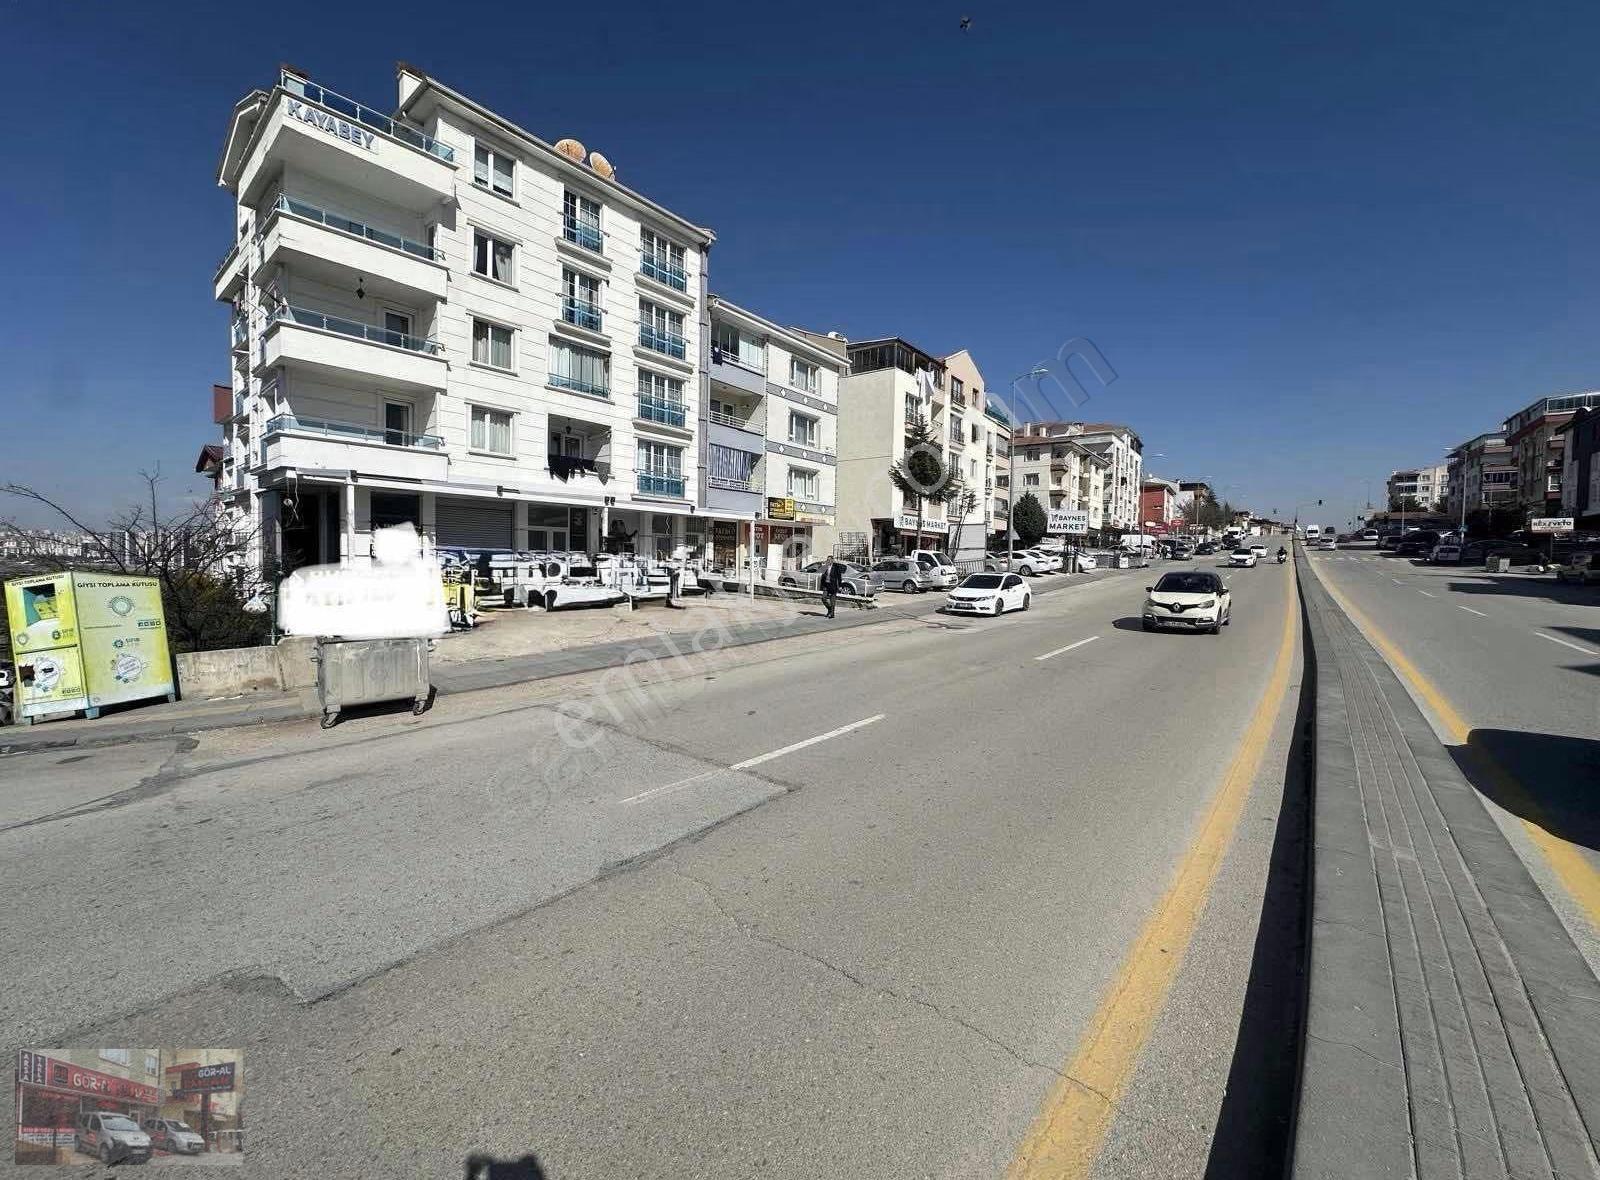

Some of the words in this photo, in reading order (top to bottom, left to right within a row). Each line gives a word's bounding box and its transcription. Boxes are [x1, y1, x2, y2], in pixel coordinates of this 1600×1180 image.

[287, 98, 375, 150] KAYABEY
[904, 517, 926, 527] BAYS
[926, 520, 946, 529] MARKET
[1049, 523, 1085, 531] MARKET
